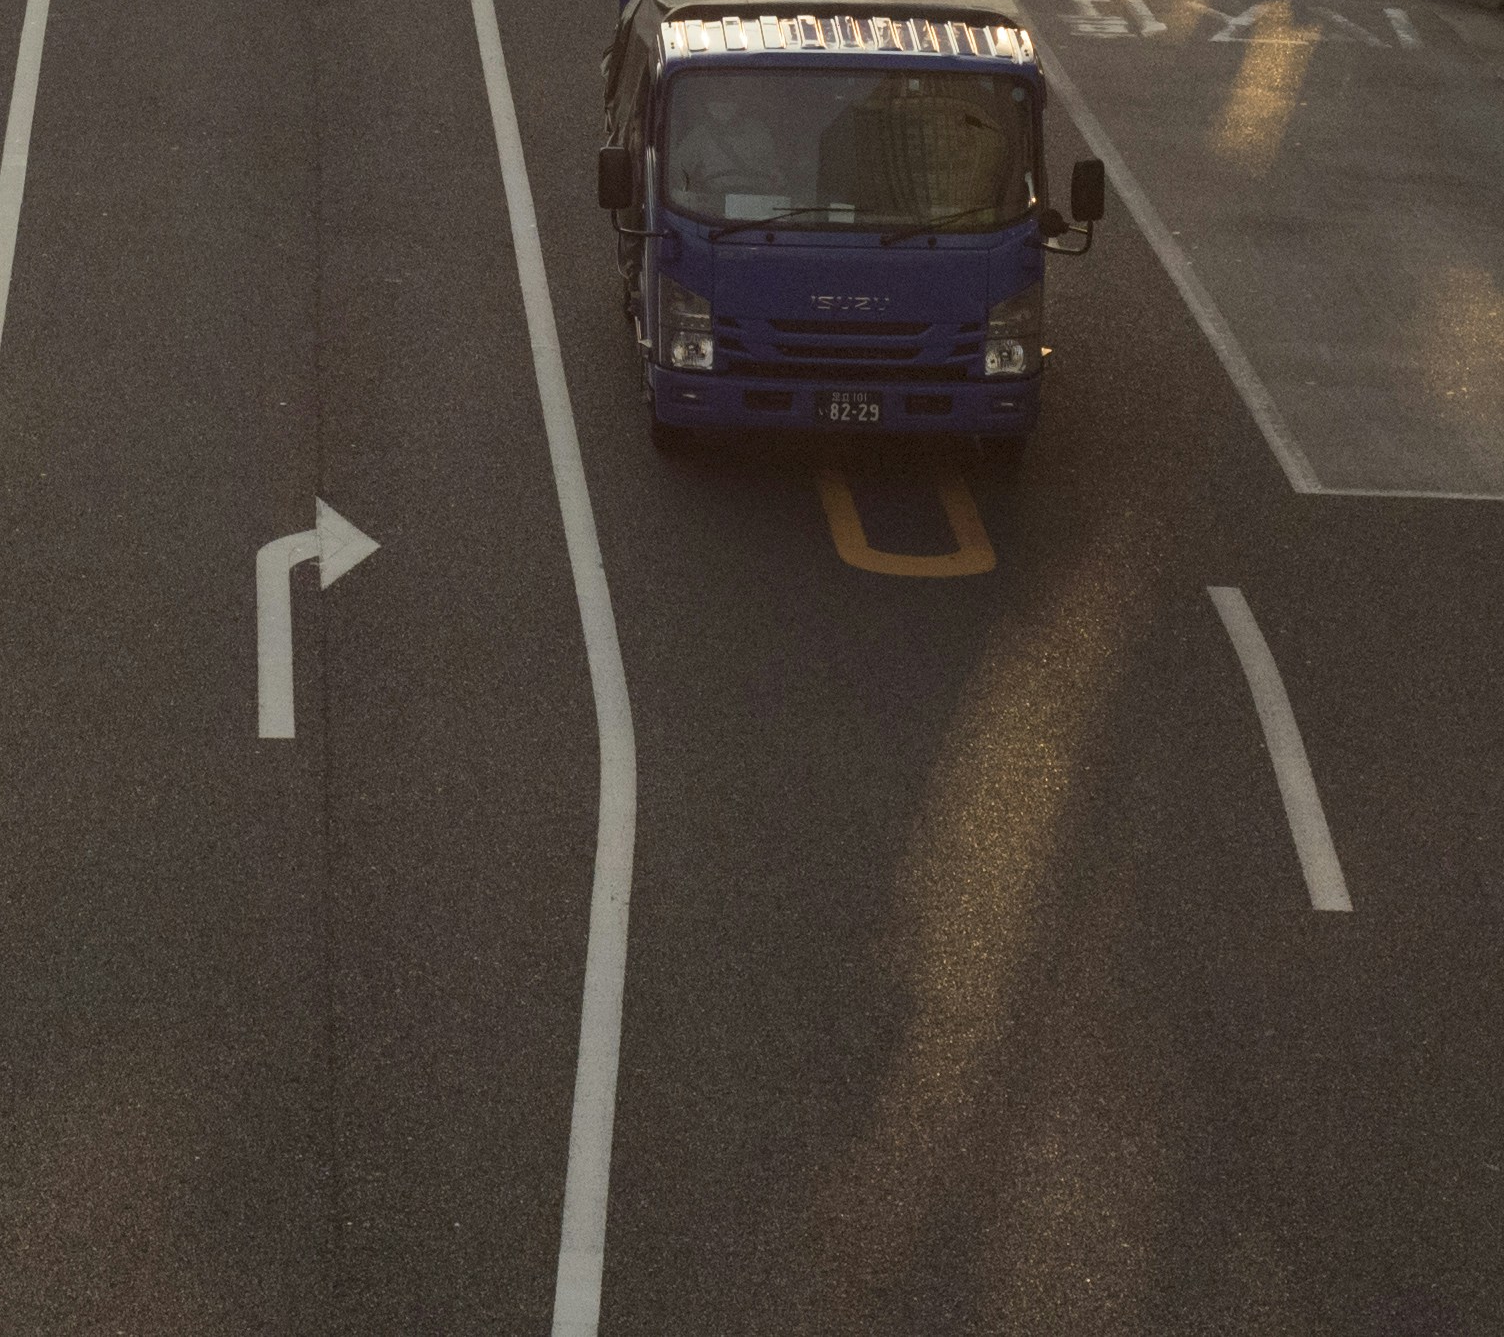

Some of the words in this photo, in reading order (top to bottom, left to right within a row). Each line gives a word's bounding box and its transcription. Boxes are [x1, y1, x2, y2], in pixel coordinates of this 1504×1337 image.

[809, 293, 892, 312] ISUZU
[830, 391, 849, 402] 足立
[828, 402, 880, 422] 82-29
